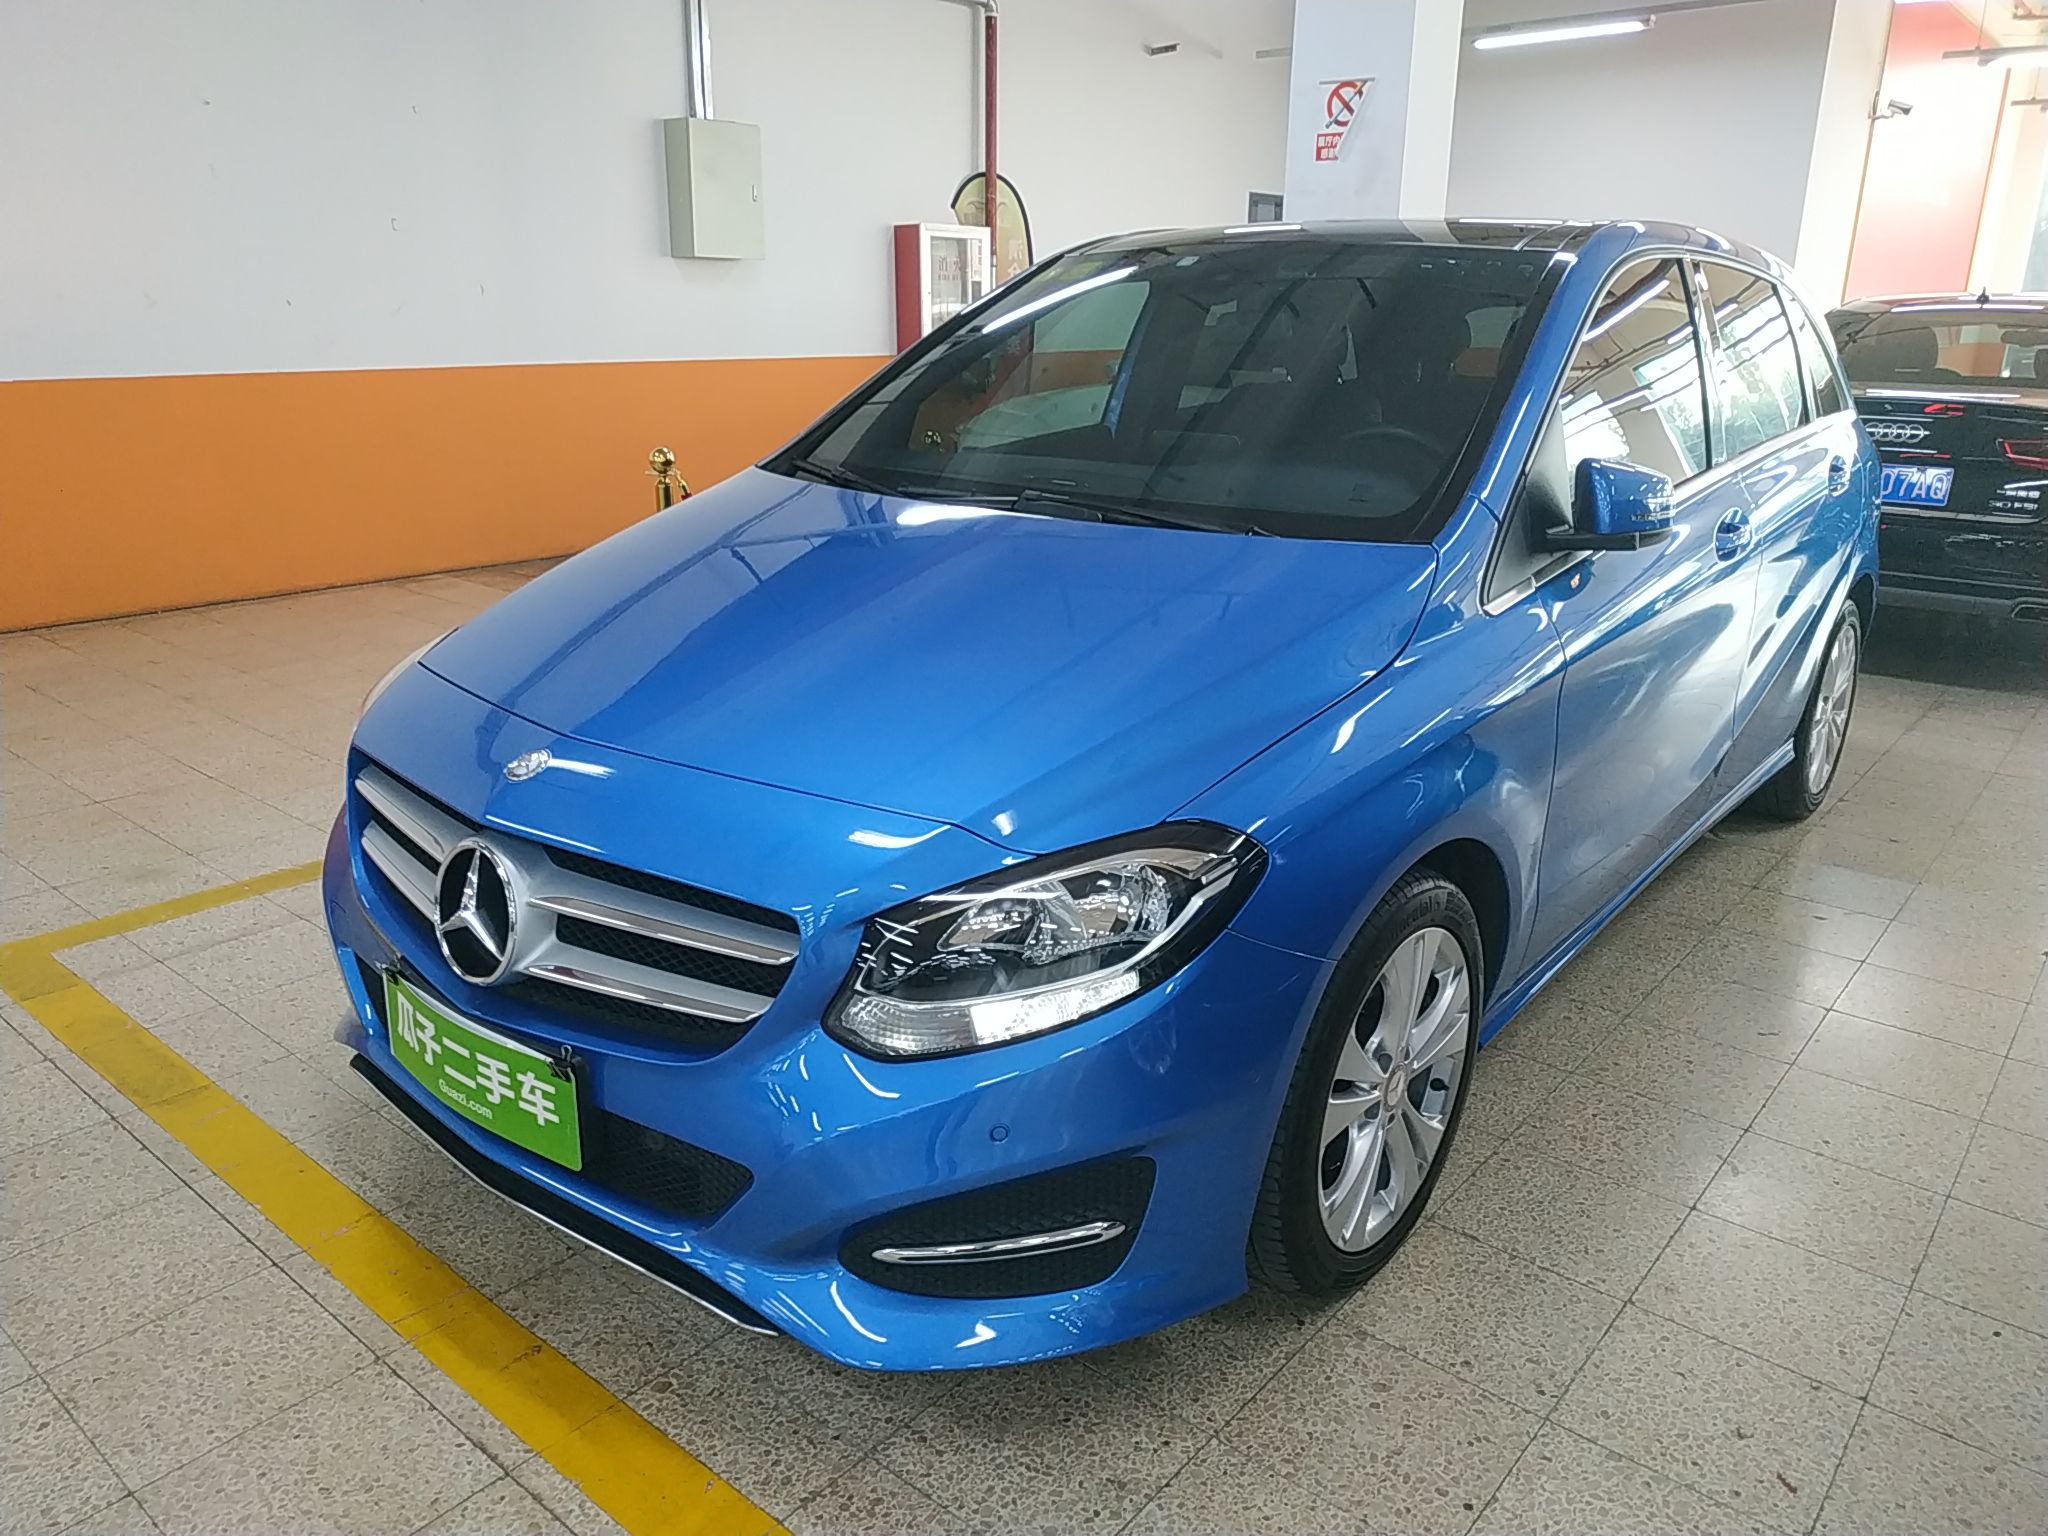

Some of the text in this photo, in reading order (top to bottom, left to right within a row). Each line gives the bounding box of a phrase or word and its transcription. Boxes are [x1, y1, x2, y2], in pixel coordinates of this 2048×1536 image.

[396, 990, 560, 1127] 瓜子二手车
